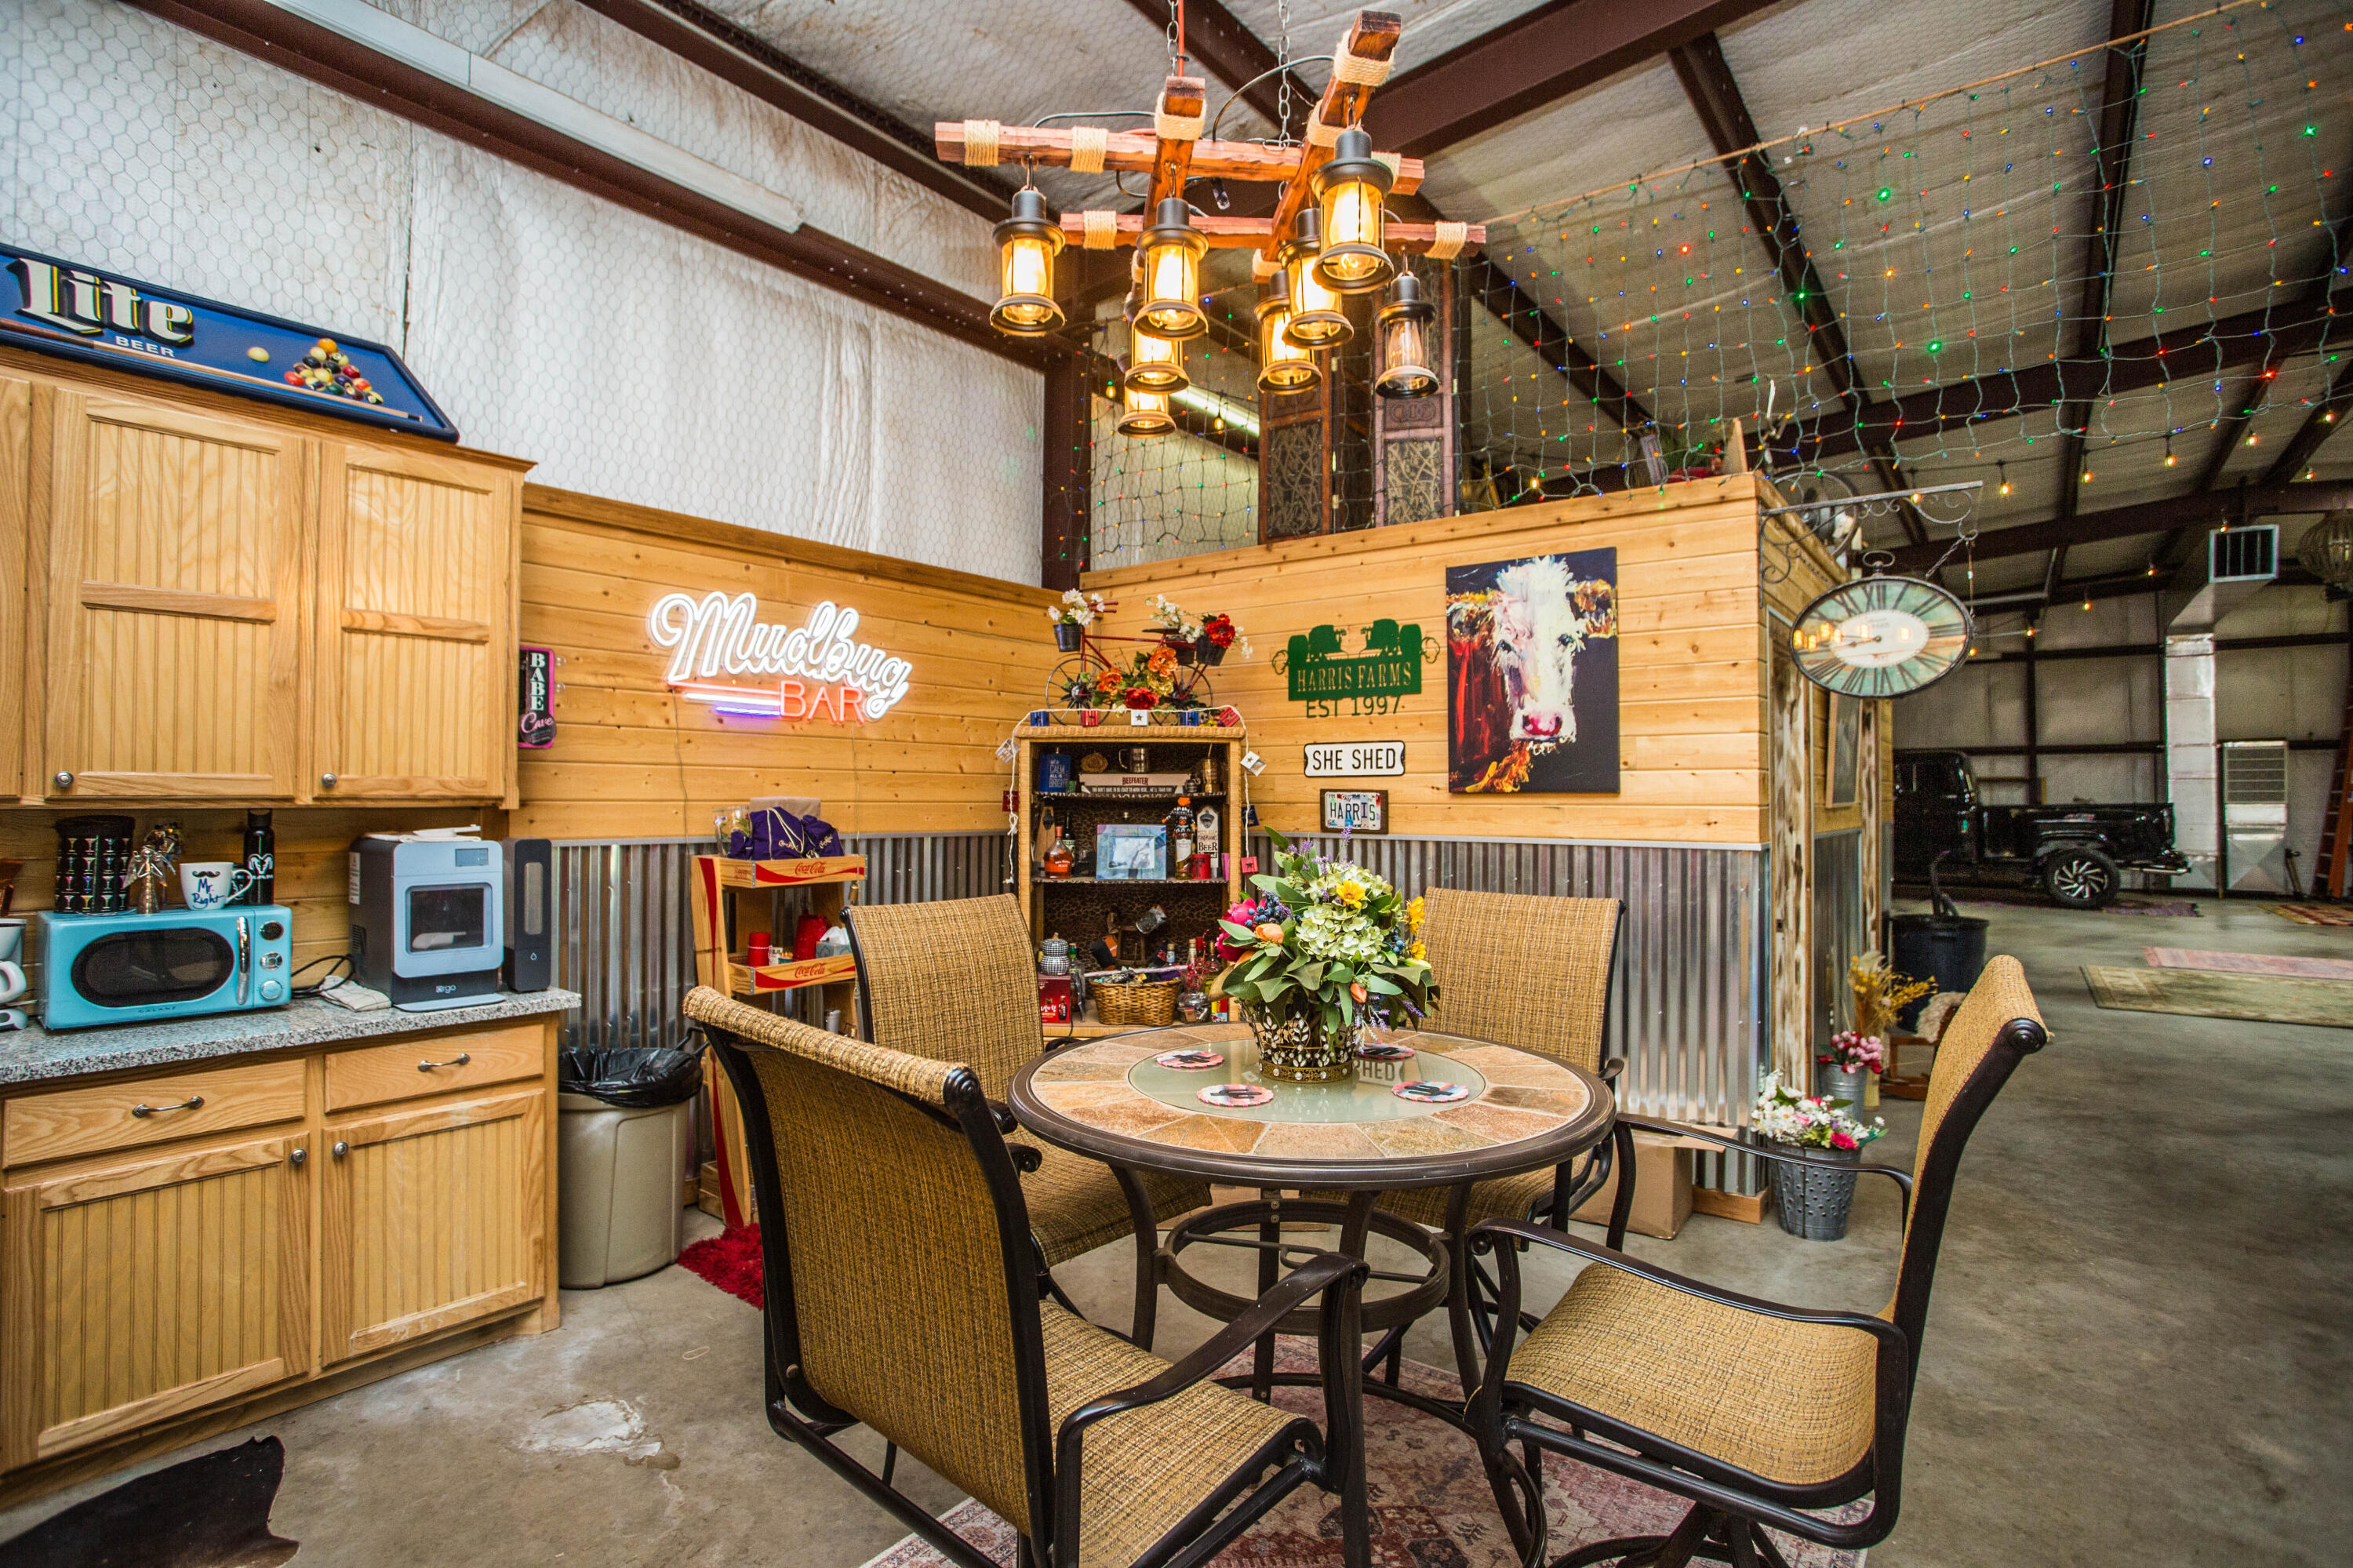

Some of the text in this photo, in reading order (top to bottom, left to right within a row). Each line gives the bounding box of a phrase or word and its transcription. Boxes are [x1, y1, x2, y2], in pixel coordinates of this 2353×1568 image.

[16, 257, 194, 345] Lite
[115, 336, 175, 358] BEER
[650, 591, 913, 719] Mudbug
[530, 652, 547, 711] BABE
[1297, 661, 1412, 693] HARRIS FARMS
[780, 680, 864, 724] BAR
[1306, 695, 1402, 719] EST 1997
[521, 711, 554, 733] Cave
[1313, 748, 1396, 770] SHE SHED
[1122, 777, 1149, 785] BEEFEATER
[1329, 802, 1376, 821] HARRIS
[1198, 842, 1217, 851] BEER
[191, 893, 225, 910] Right
